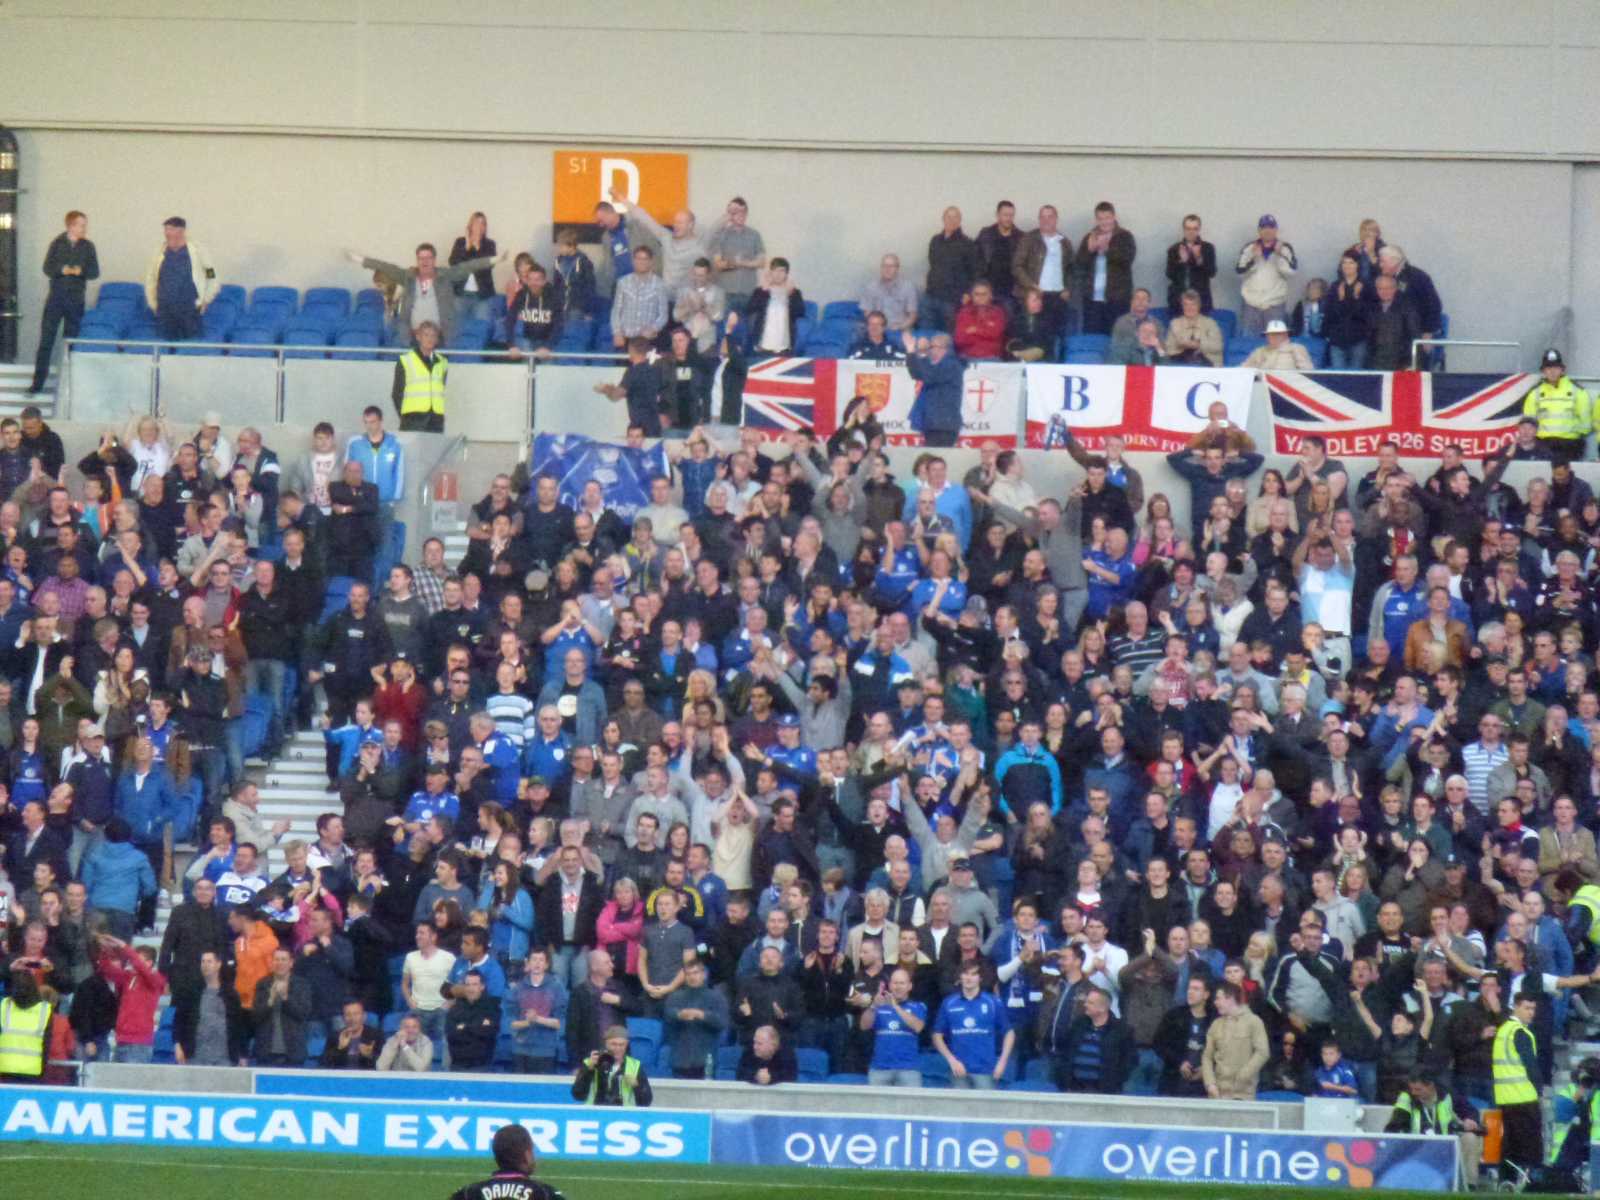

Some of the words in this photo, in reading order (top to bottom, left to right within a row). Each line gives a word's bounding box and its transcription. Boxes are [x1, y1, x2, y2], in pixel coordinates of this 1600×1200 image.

[600, 158, 641, 215] D
[1059, 374, 1090, 412] B
[1186, 381, 1221, 420] C
[3, 1098, 361, 1147] AMERICAN
[383, 1113, 685, 1157] EXPRESS
[784, 1121, 1000, 1169] overline
[1102, 1134, 1320, 1181] overline
[481, 1183, 534, 1200] DAVIES
